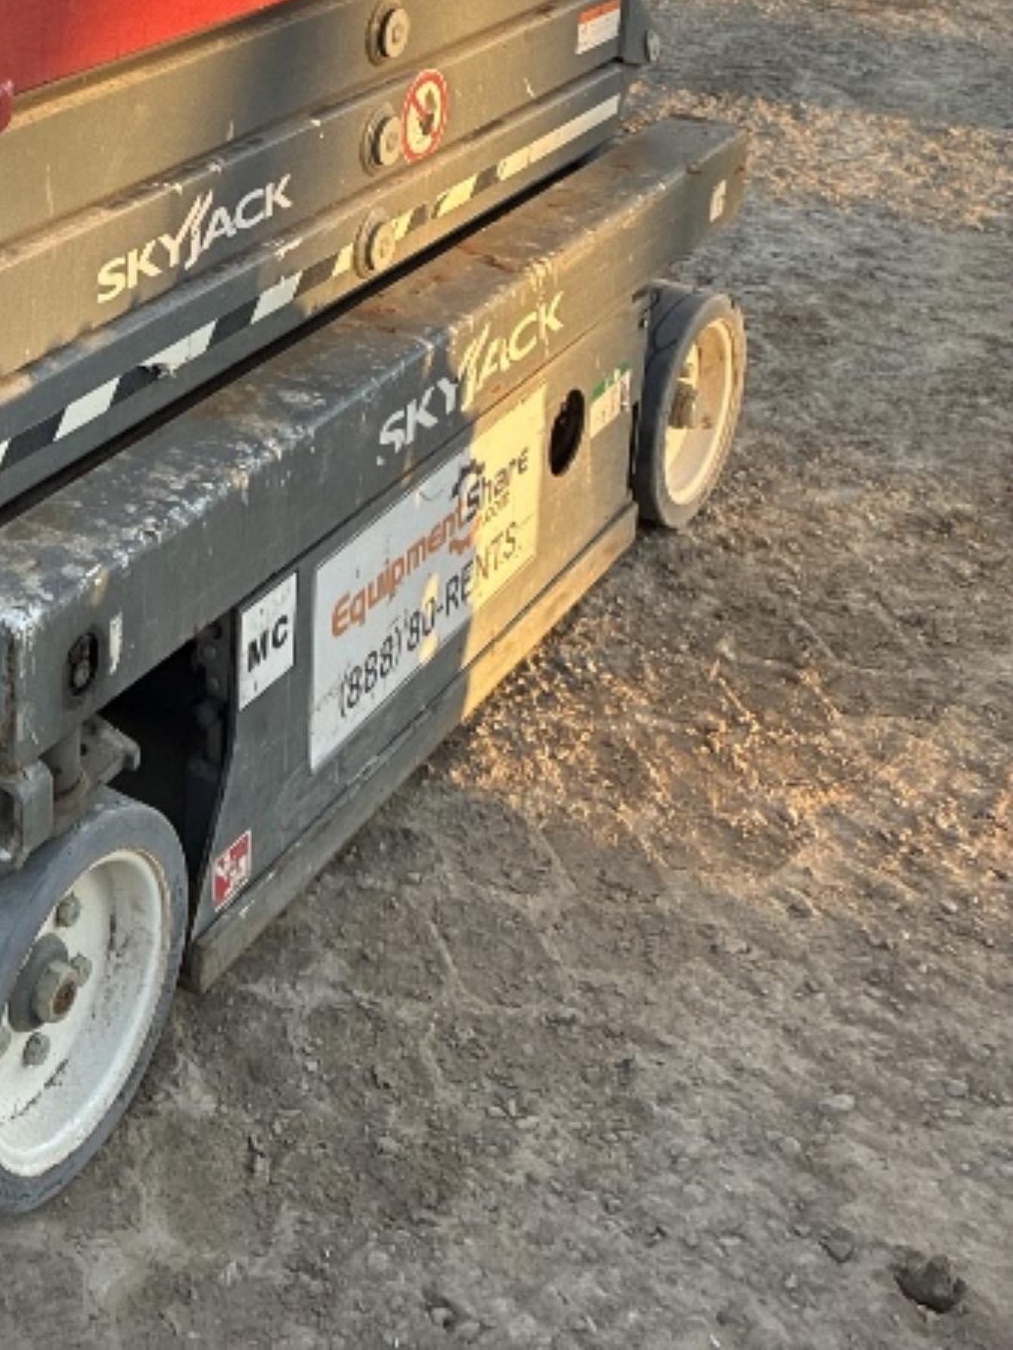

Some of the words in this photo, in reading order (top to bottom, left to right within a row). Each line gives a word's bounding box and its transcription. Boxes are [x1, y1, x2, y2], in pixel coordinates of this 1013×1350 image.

[96, 174, 294, 305] SKYJACK
[376, 290, 565, 467] SKYJACK
[331, 446, 529, 638] EquipmentShare
[247, 613, 288, 673] MC
